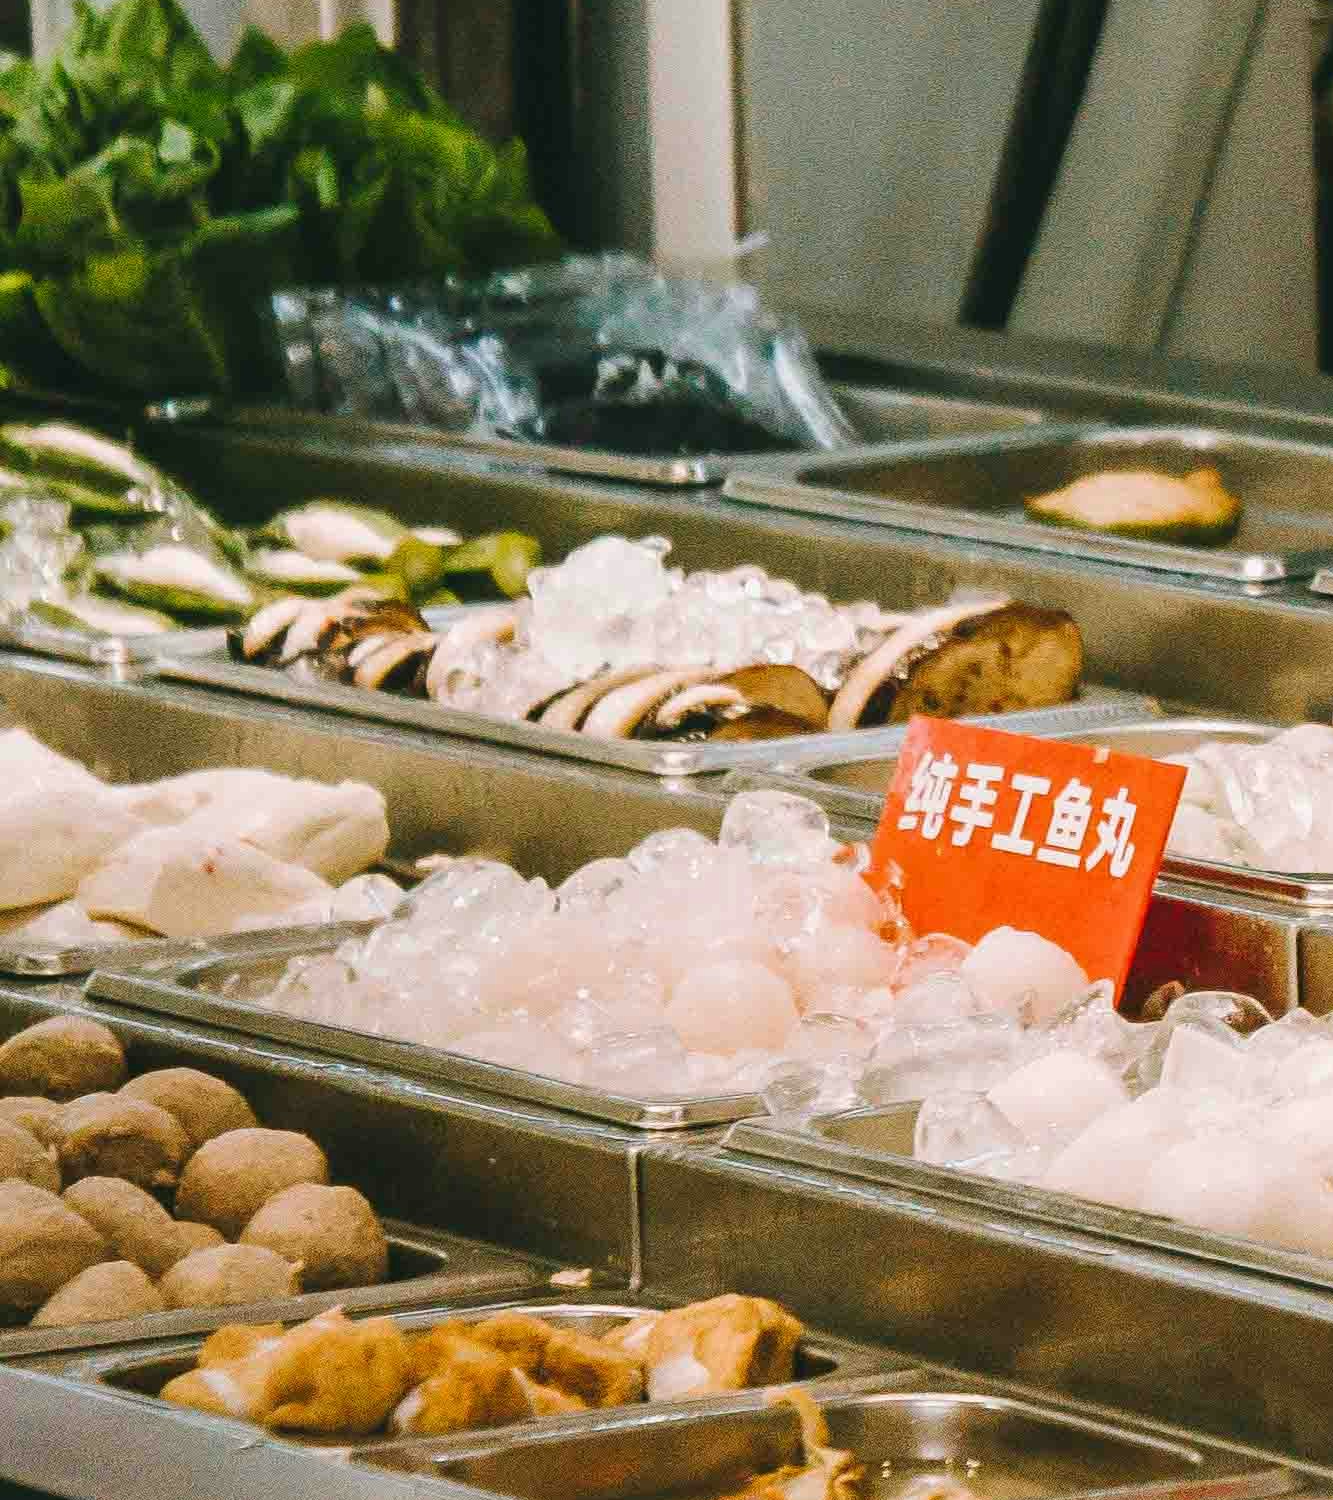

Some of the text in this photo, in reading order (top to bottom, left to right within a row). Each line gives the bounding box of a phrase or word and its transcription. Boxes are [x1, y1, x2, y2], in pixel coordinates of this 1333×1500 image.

[897, 750, 1137, 879] 纯手工鱼丸
